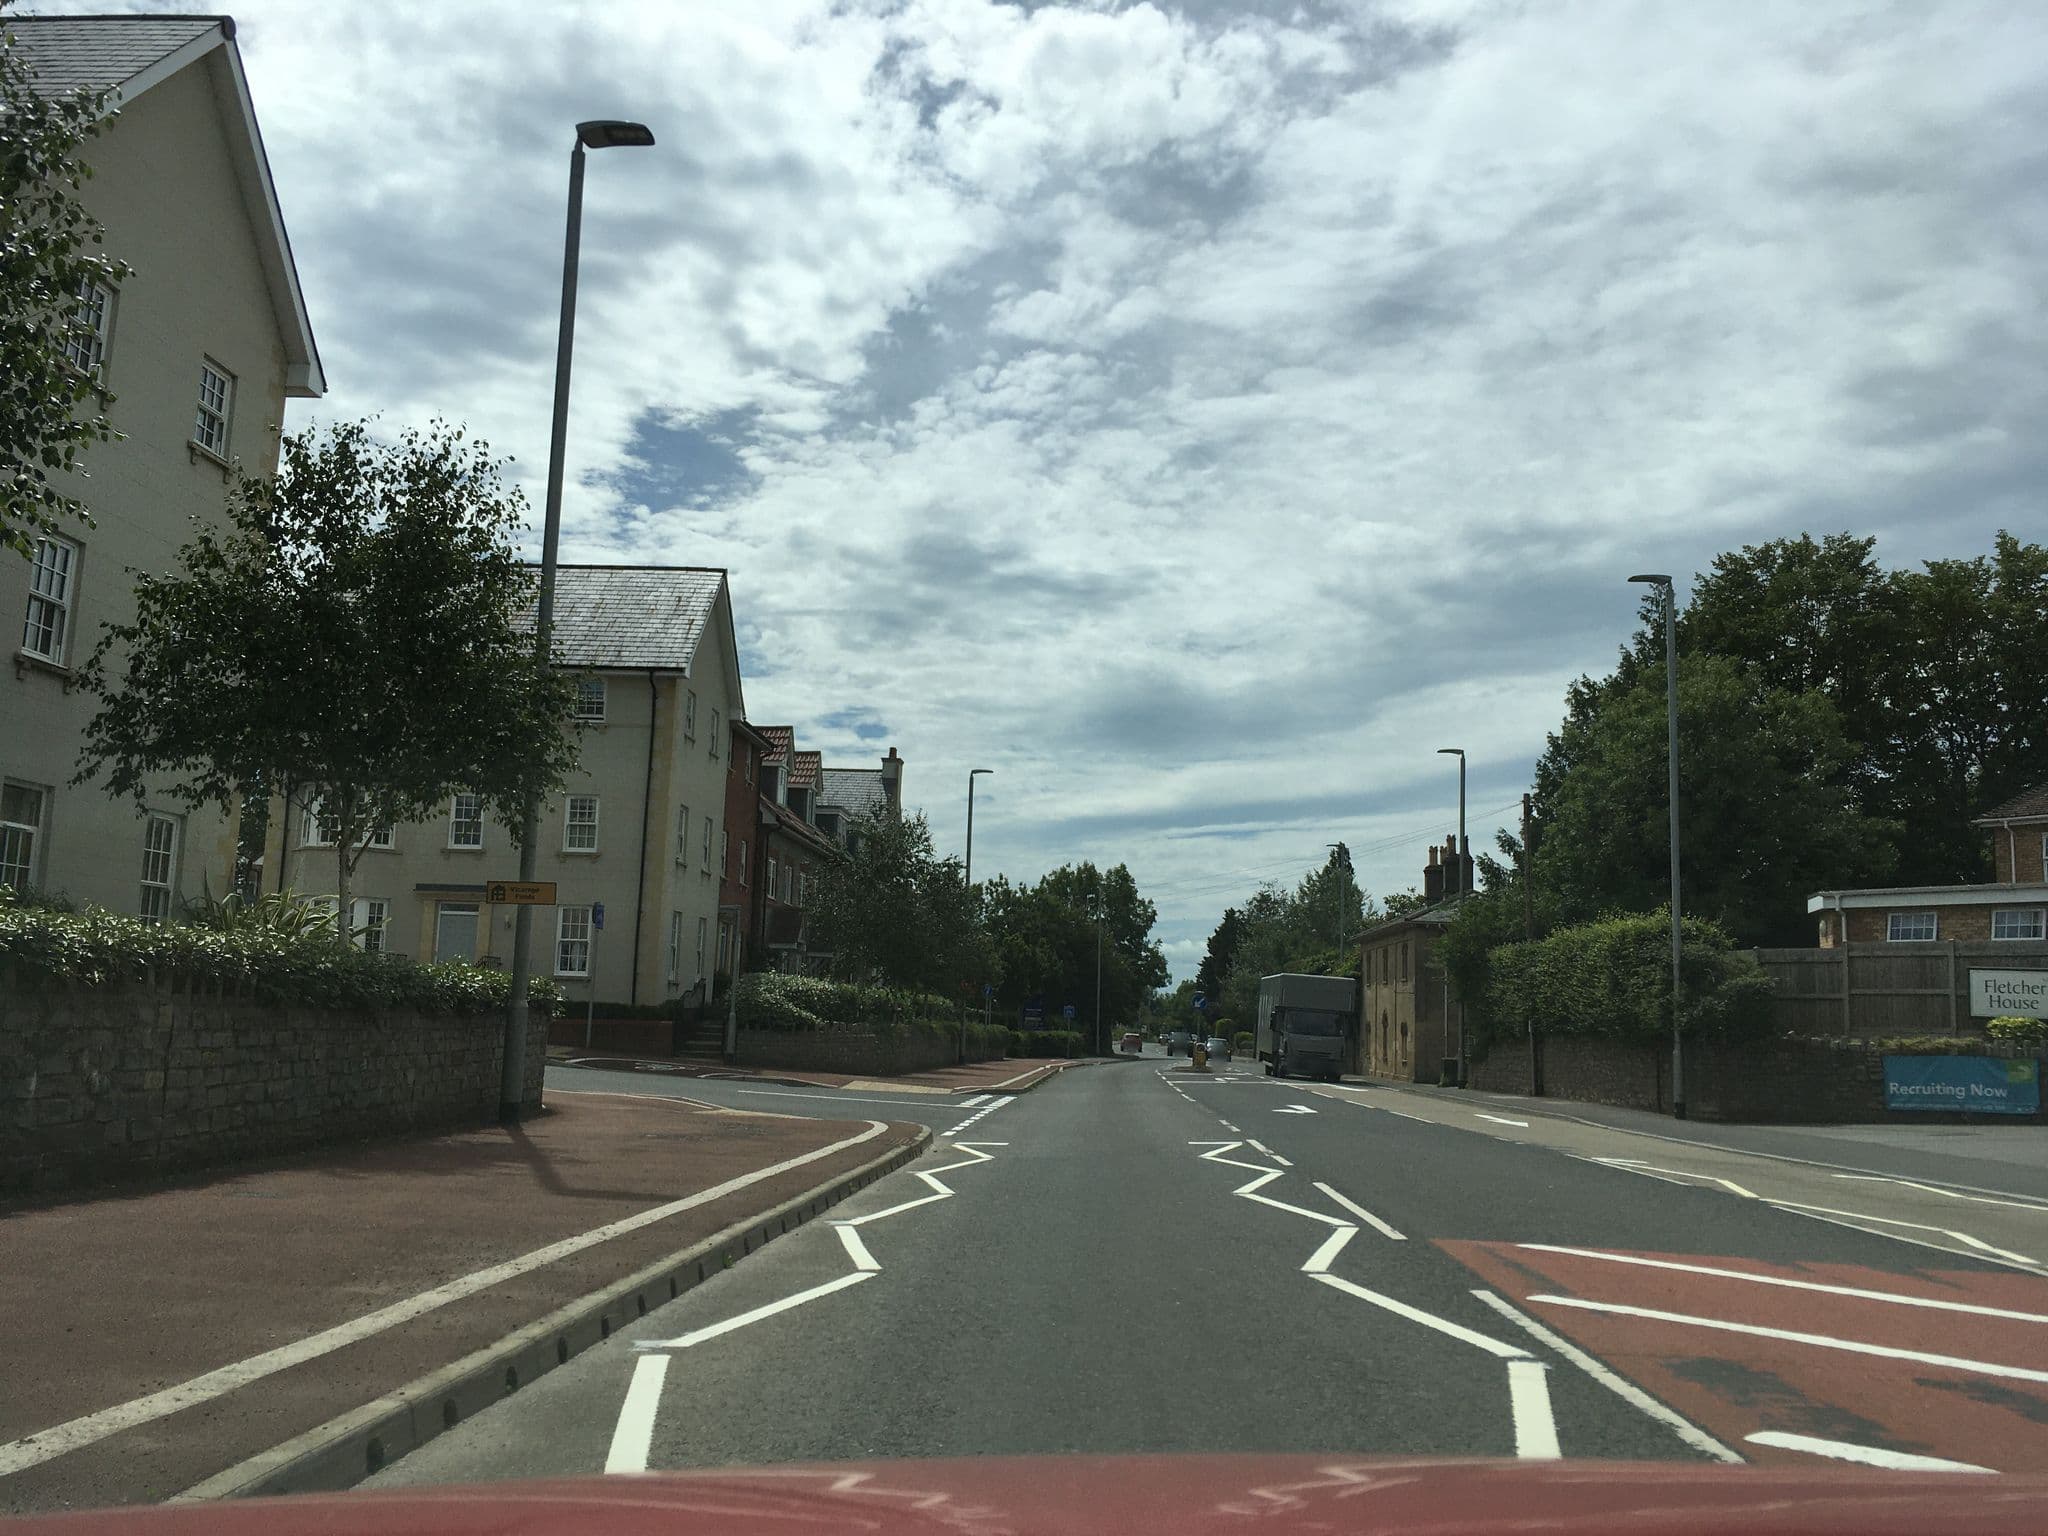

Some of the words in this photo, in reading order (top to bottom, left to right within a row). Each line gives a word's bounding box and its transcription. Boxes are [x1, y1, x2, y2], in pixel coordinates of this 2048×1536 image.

[1984, 979, 2047, 995] Fletcher
[1989, 995, 2039, 1010] House
[1889, 1082, 1966, 1099] Recruiting
[1970, 1083, 2008, 1098] Now
